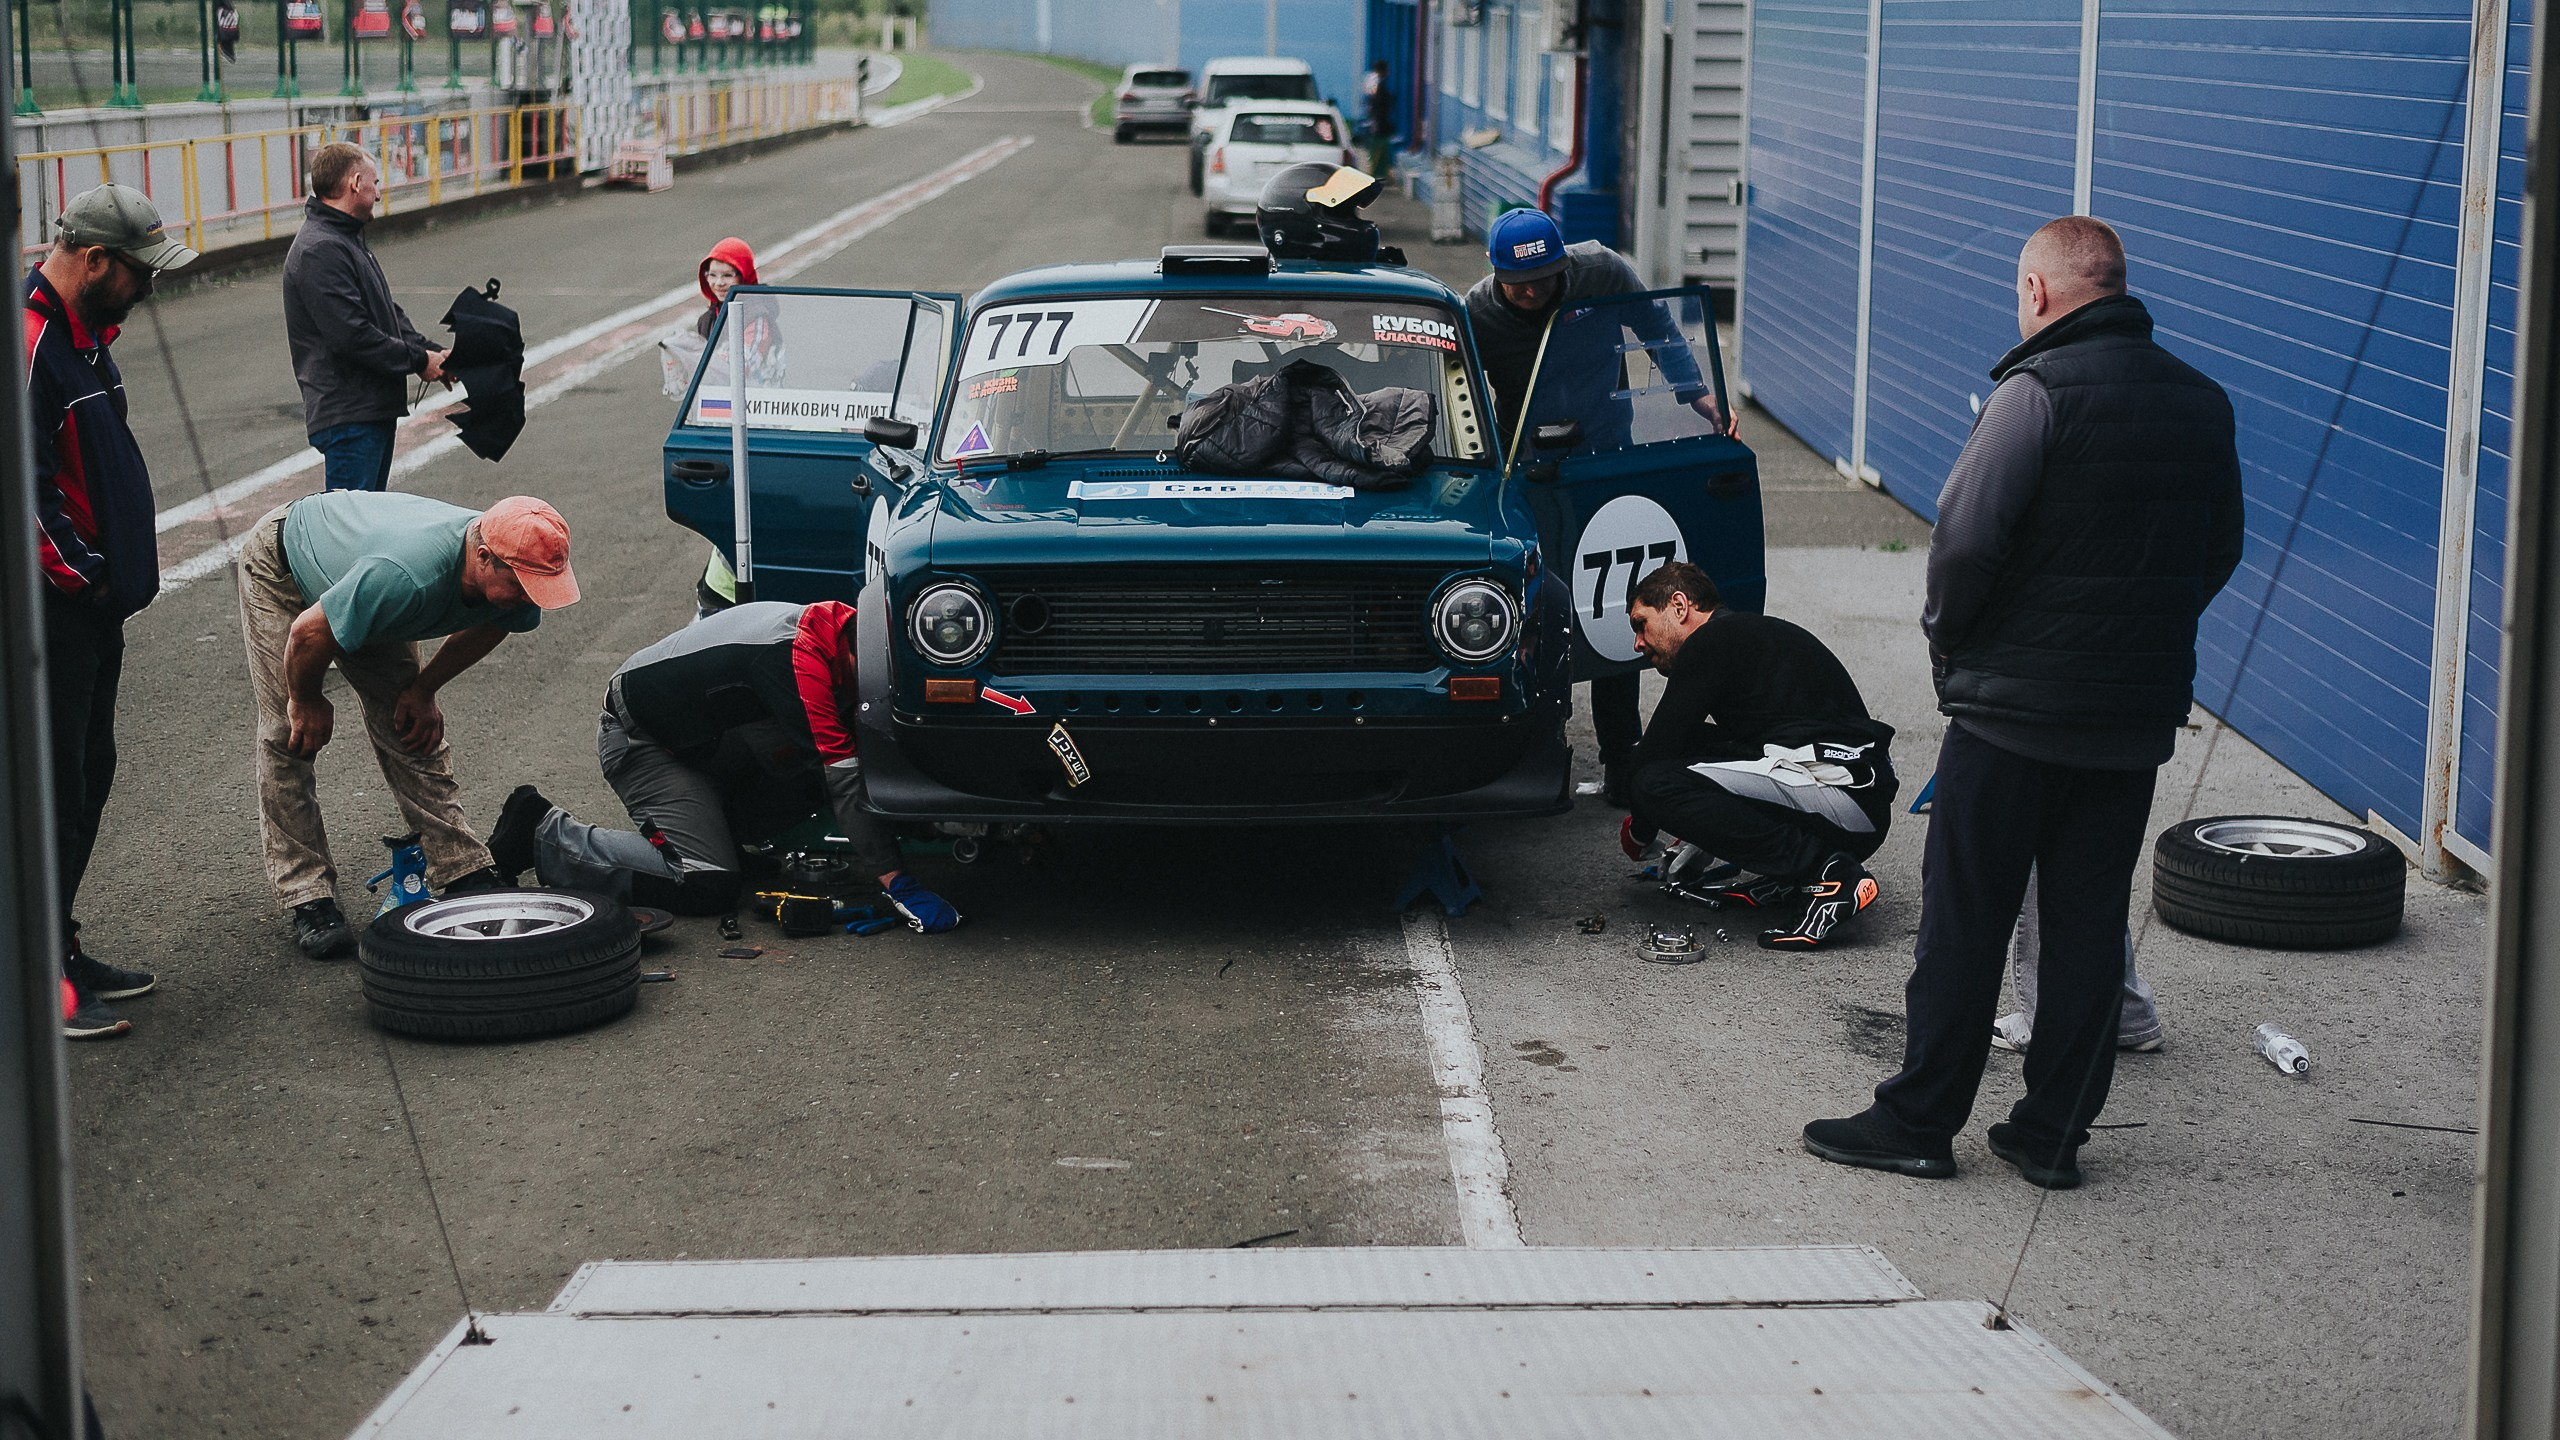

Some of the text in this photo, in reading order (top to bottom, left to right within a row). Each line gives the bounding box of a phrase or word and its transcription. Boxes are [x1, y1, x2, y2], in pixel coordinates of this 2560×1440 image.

[1372, 314, 1456, 340] КУБОК
[988, 311, 1074, 361] 777
[1374, 330, 1457, 352] КЛАССИКИ
[980, 384, 1017, 398] ДОРОГАХ
[984, 377, 1018, 389] ЖИЗНЬ
[844, 404, 892, 421] ДМИТ
[1824, 749, 1861, 760] sparco
